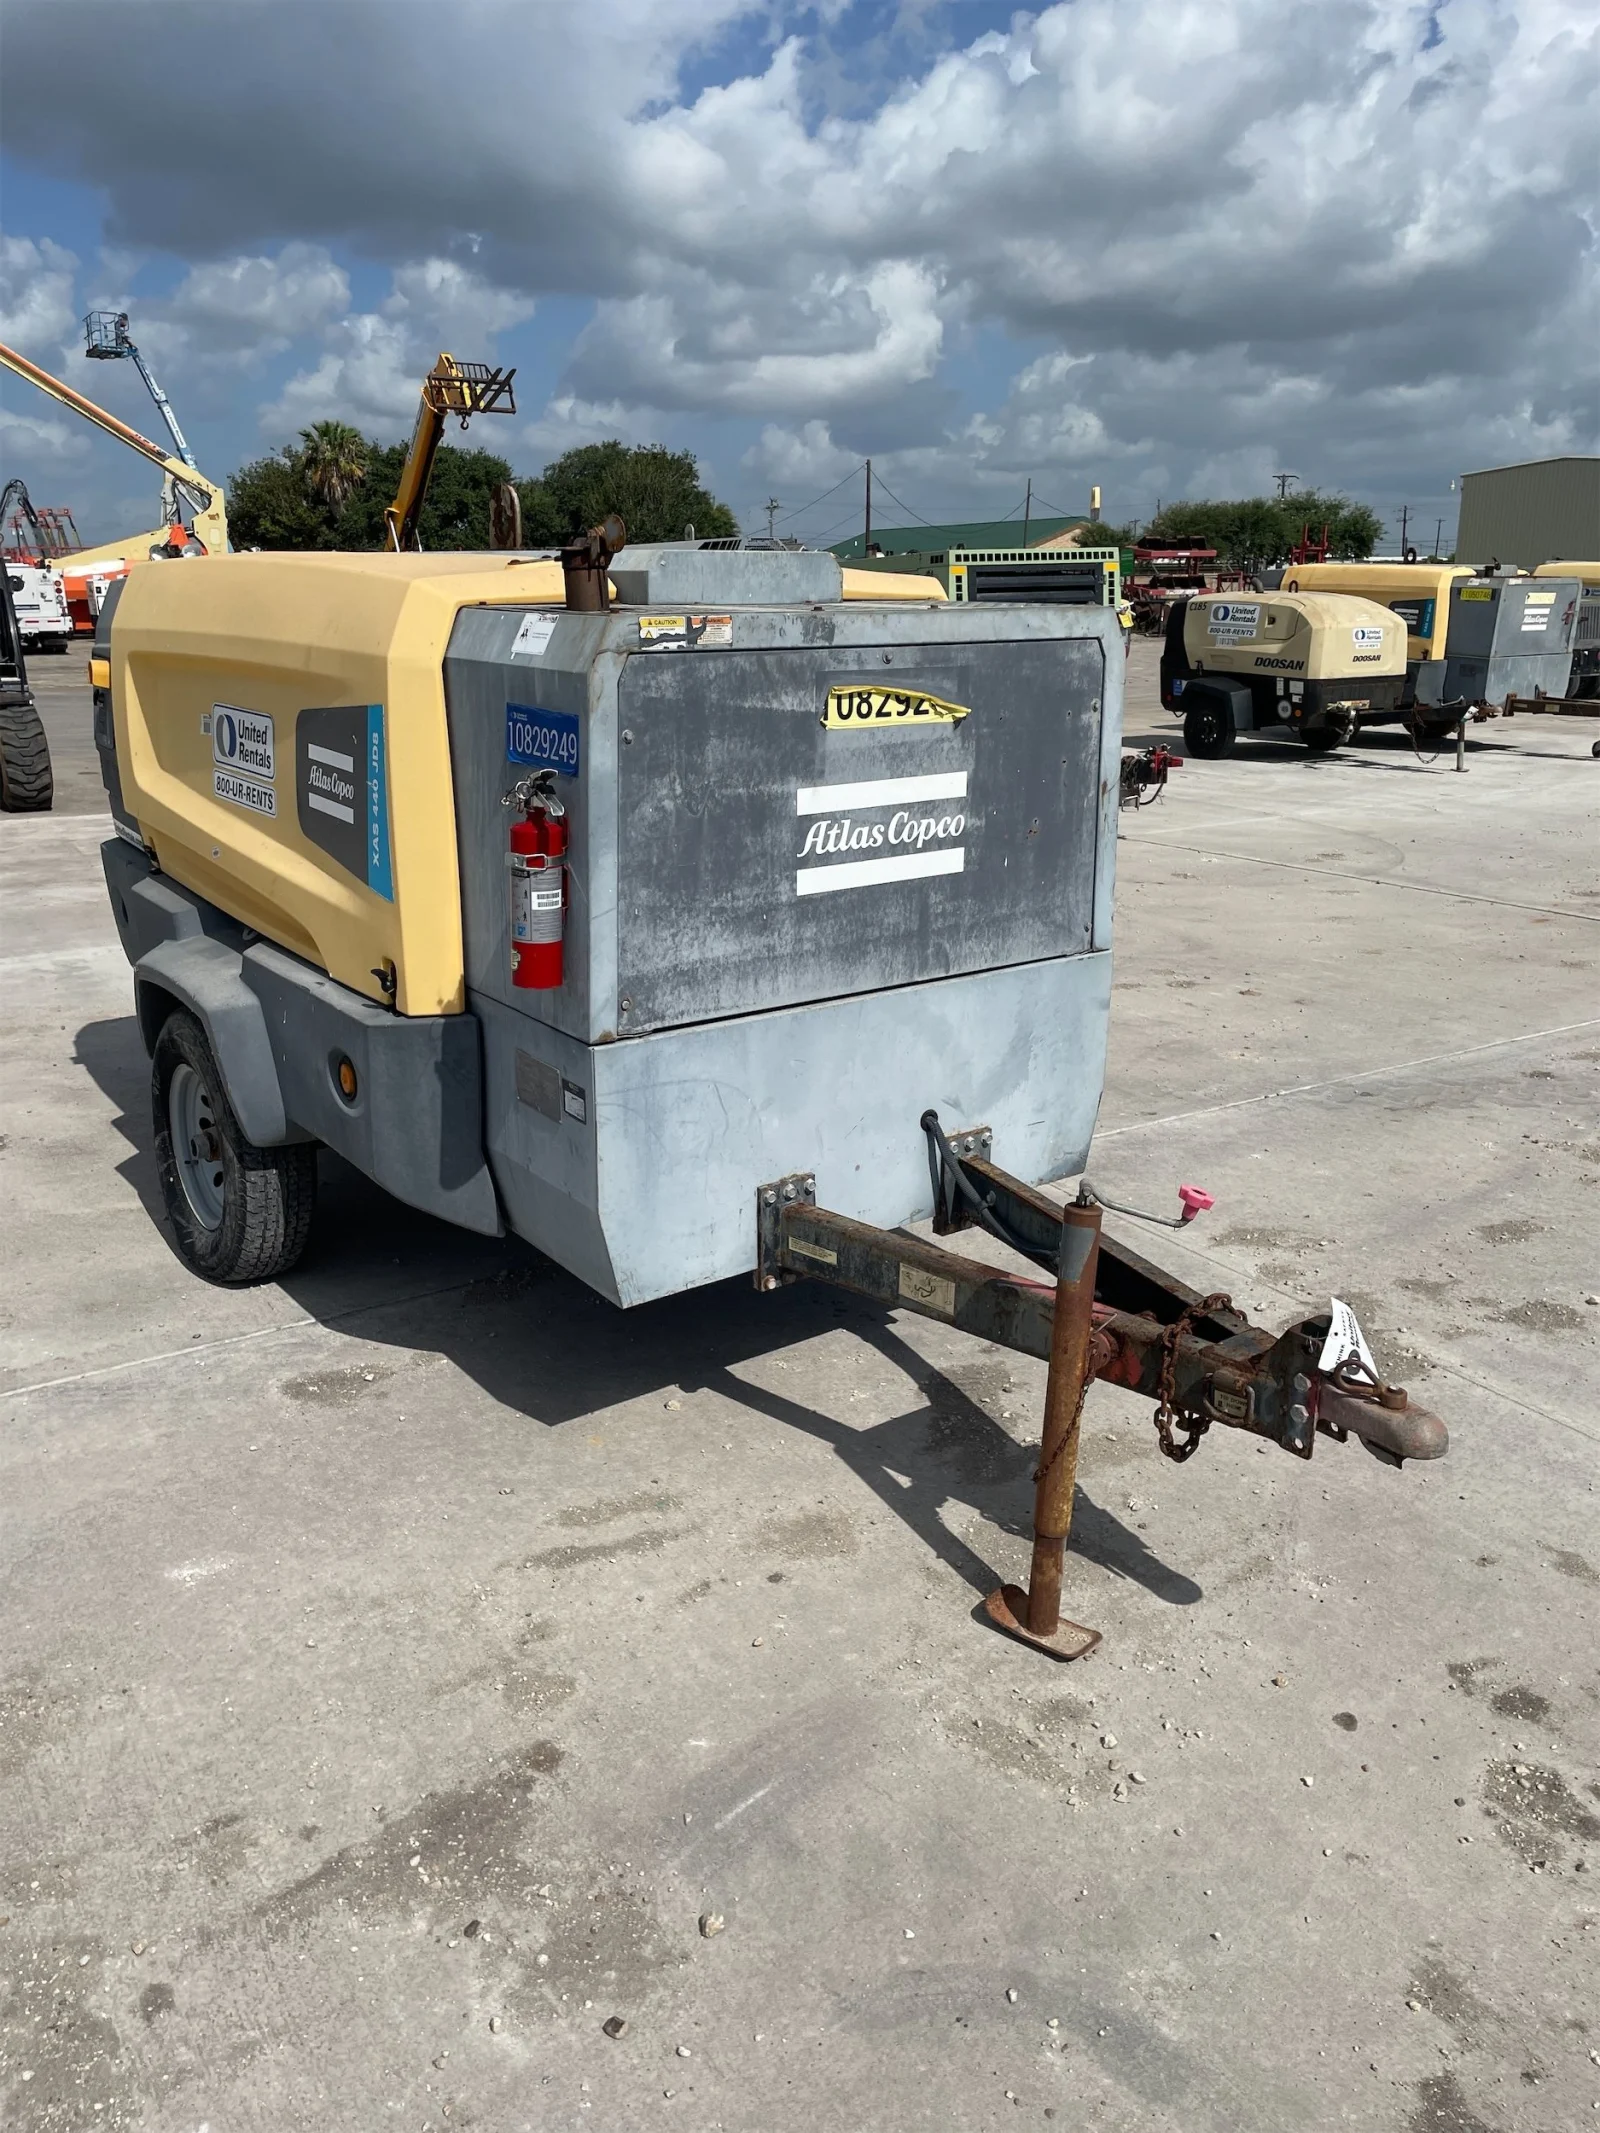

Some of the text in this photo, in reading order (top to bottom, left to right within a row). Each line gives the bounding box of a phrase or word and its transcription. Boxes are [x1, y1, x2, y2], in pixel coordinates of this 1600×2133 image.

[1229, 615, 1257, 624] Rentals
[1231, 606, 1257, 615] United
[1209, 627, 1254, 636] 800-UR-RENTS
[1254, 656, 1305, 671] DOOSAN
[238, 718, 268, 746] United
[508, 721, 577, 765] 10829249
[238, 741, 272, 770] Rentals
[216, 775, 274, 811] 800-UR-RENTS
[308, 764, 355, 801] Atlas Copco
[372, 778, 380, 816] 440
[372, 822, 380, 867] XAS
[796, 811, 966, 858] Atlas Copco
